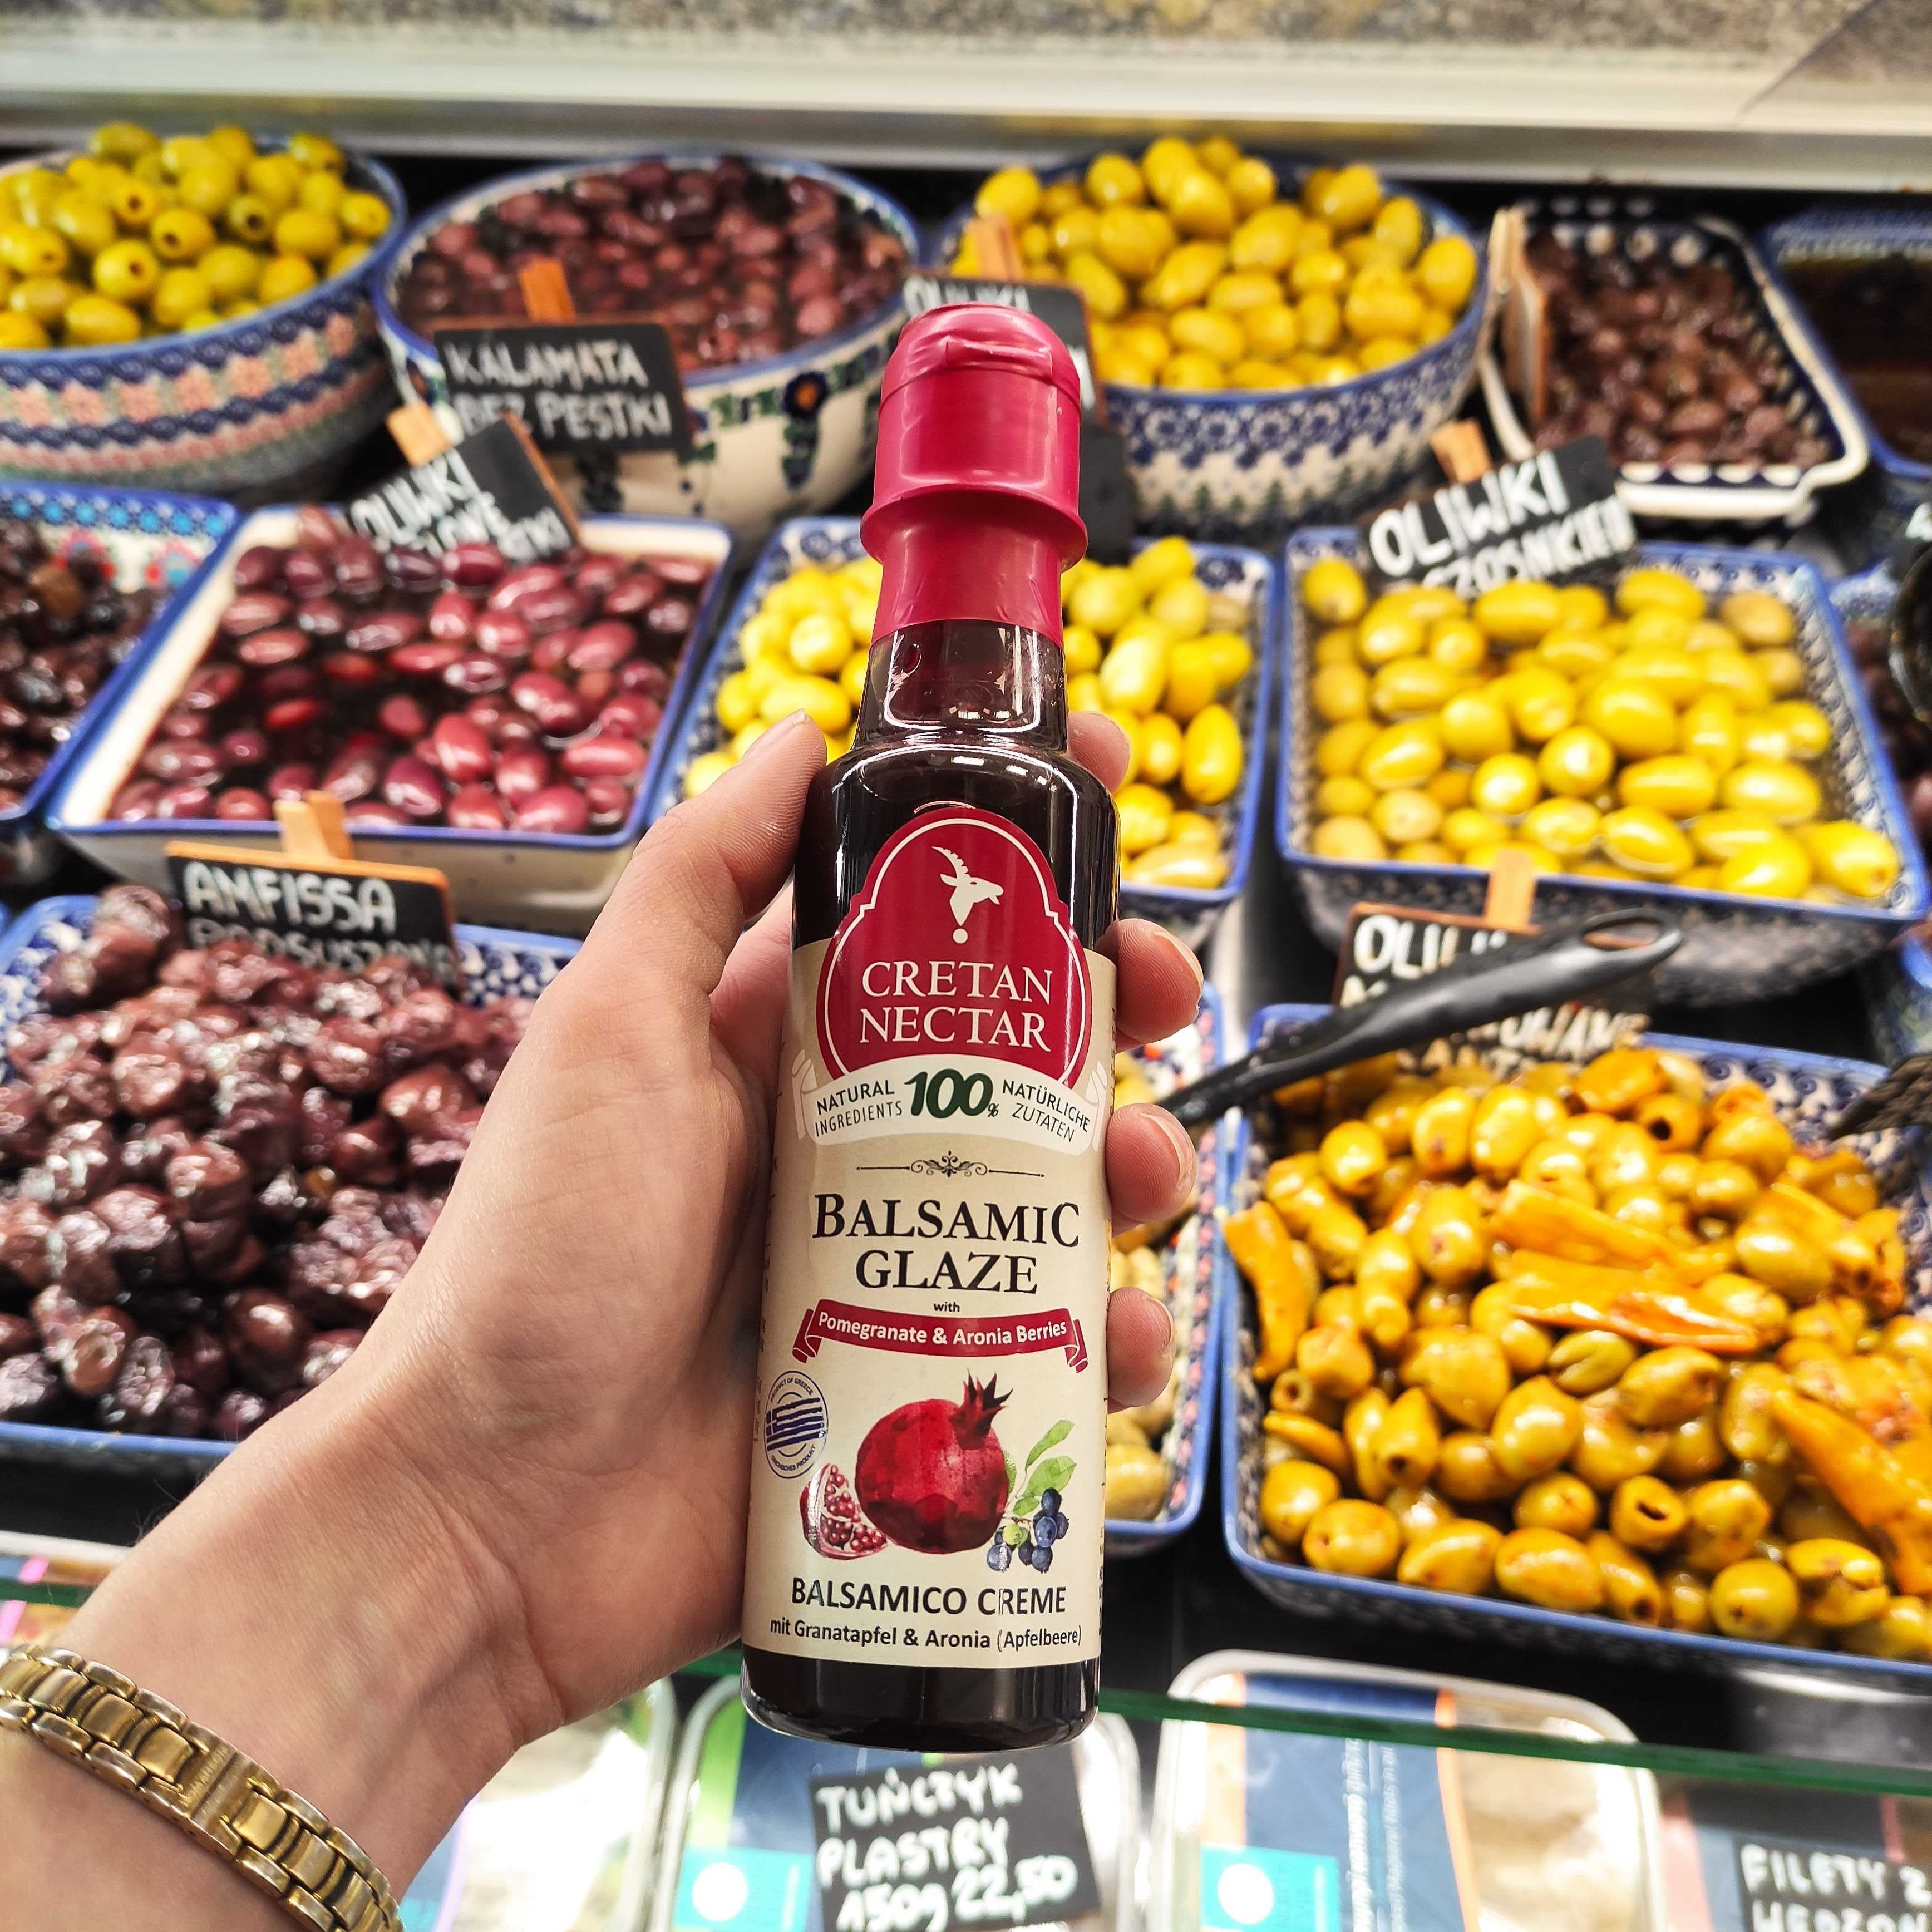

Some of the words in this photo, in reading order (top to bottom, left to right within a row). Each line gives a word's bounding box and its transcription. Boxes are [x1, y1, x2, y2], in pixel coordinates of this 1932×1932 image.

[446, 338, 650, 390] KALAMATA
[535, 392, 673, 438] PESTKI
[1369, 450, 1569, 577] OLIWKI
[862, 960, 1053, 1006] CRETAN
[859, 1006, 1051, 1053] NECTAR
[815, 1100, 903, 1137] INGREDIENTS
[816, 1080, 895, 1116] NATURAL
[1002, 1078, 1091, 1133] NATÜRLICHE
[1011, 1102, 1076, 1143] ZUTATEN
[812, 1192, 1080, 1248] BALSAMIC
[855, 1249, 1038, 1294] GLAZE
[818, 1311, 928, 1344] Pomegranate
[931, 1327, 948, 1345] &
[952, 1327, 1012, 1345] Aronia
[1016, 1319, 1067, 1343] Berries
[933, 1301, 960, 1313] with
[791, 1576, 967, 1614] BALSAMICO
[977, 1586, 1066, 1616] CREME
[770, 1617, 791, 1636] mit
[793, 1619, 896, 1648] Granatapfel
[903, 1628, 919, 1648] &
[924, 1628, 990, 1649] Aronia
[996, 1624, 1082, 1652] (Apfelbeere)
[815, 1762, 1023, 1835] TUŃCZYK
[816, 1816, 1008, 1890] PLASTRY
[1741, 1843, 1886, 1900] FILETY
